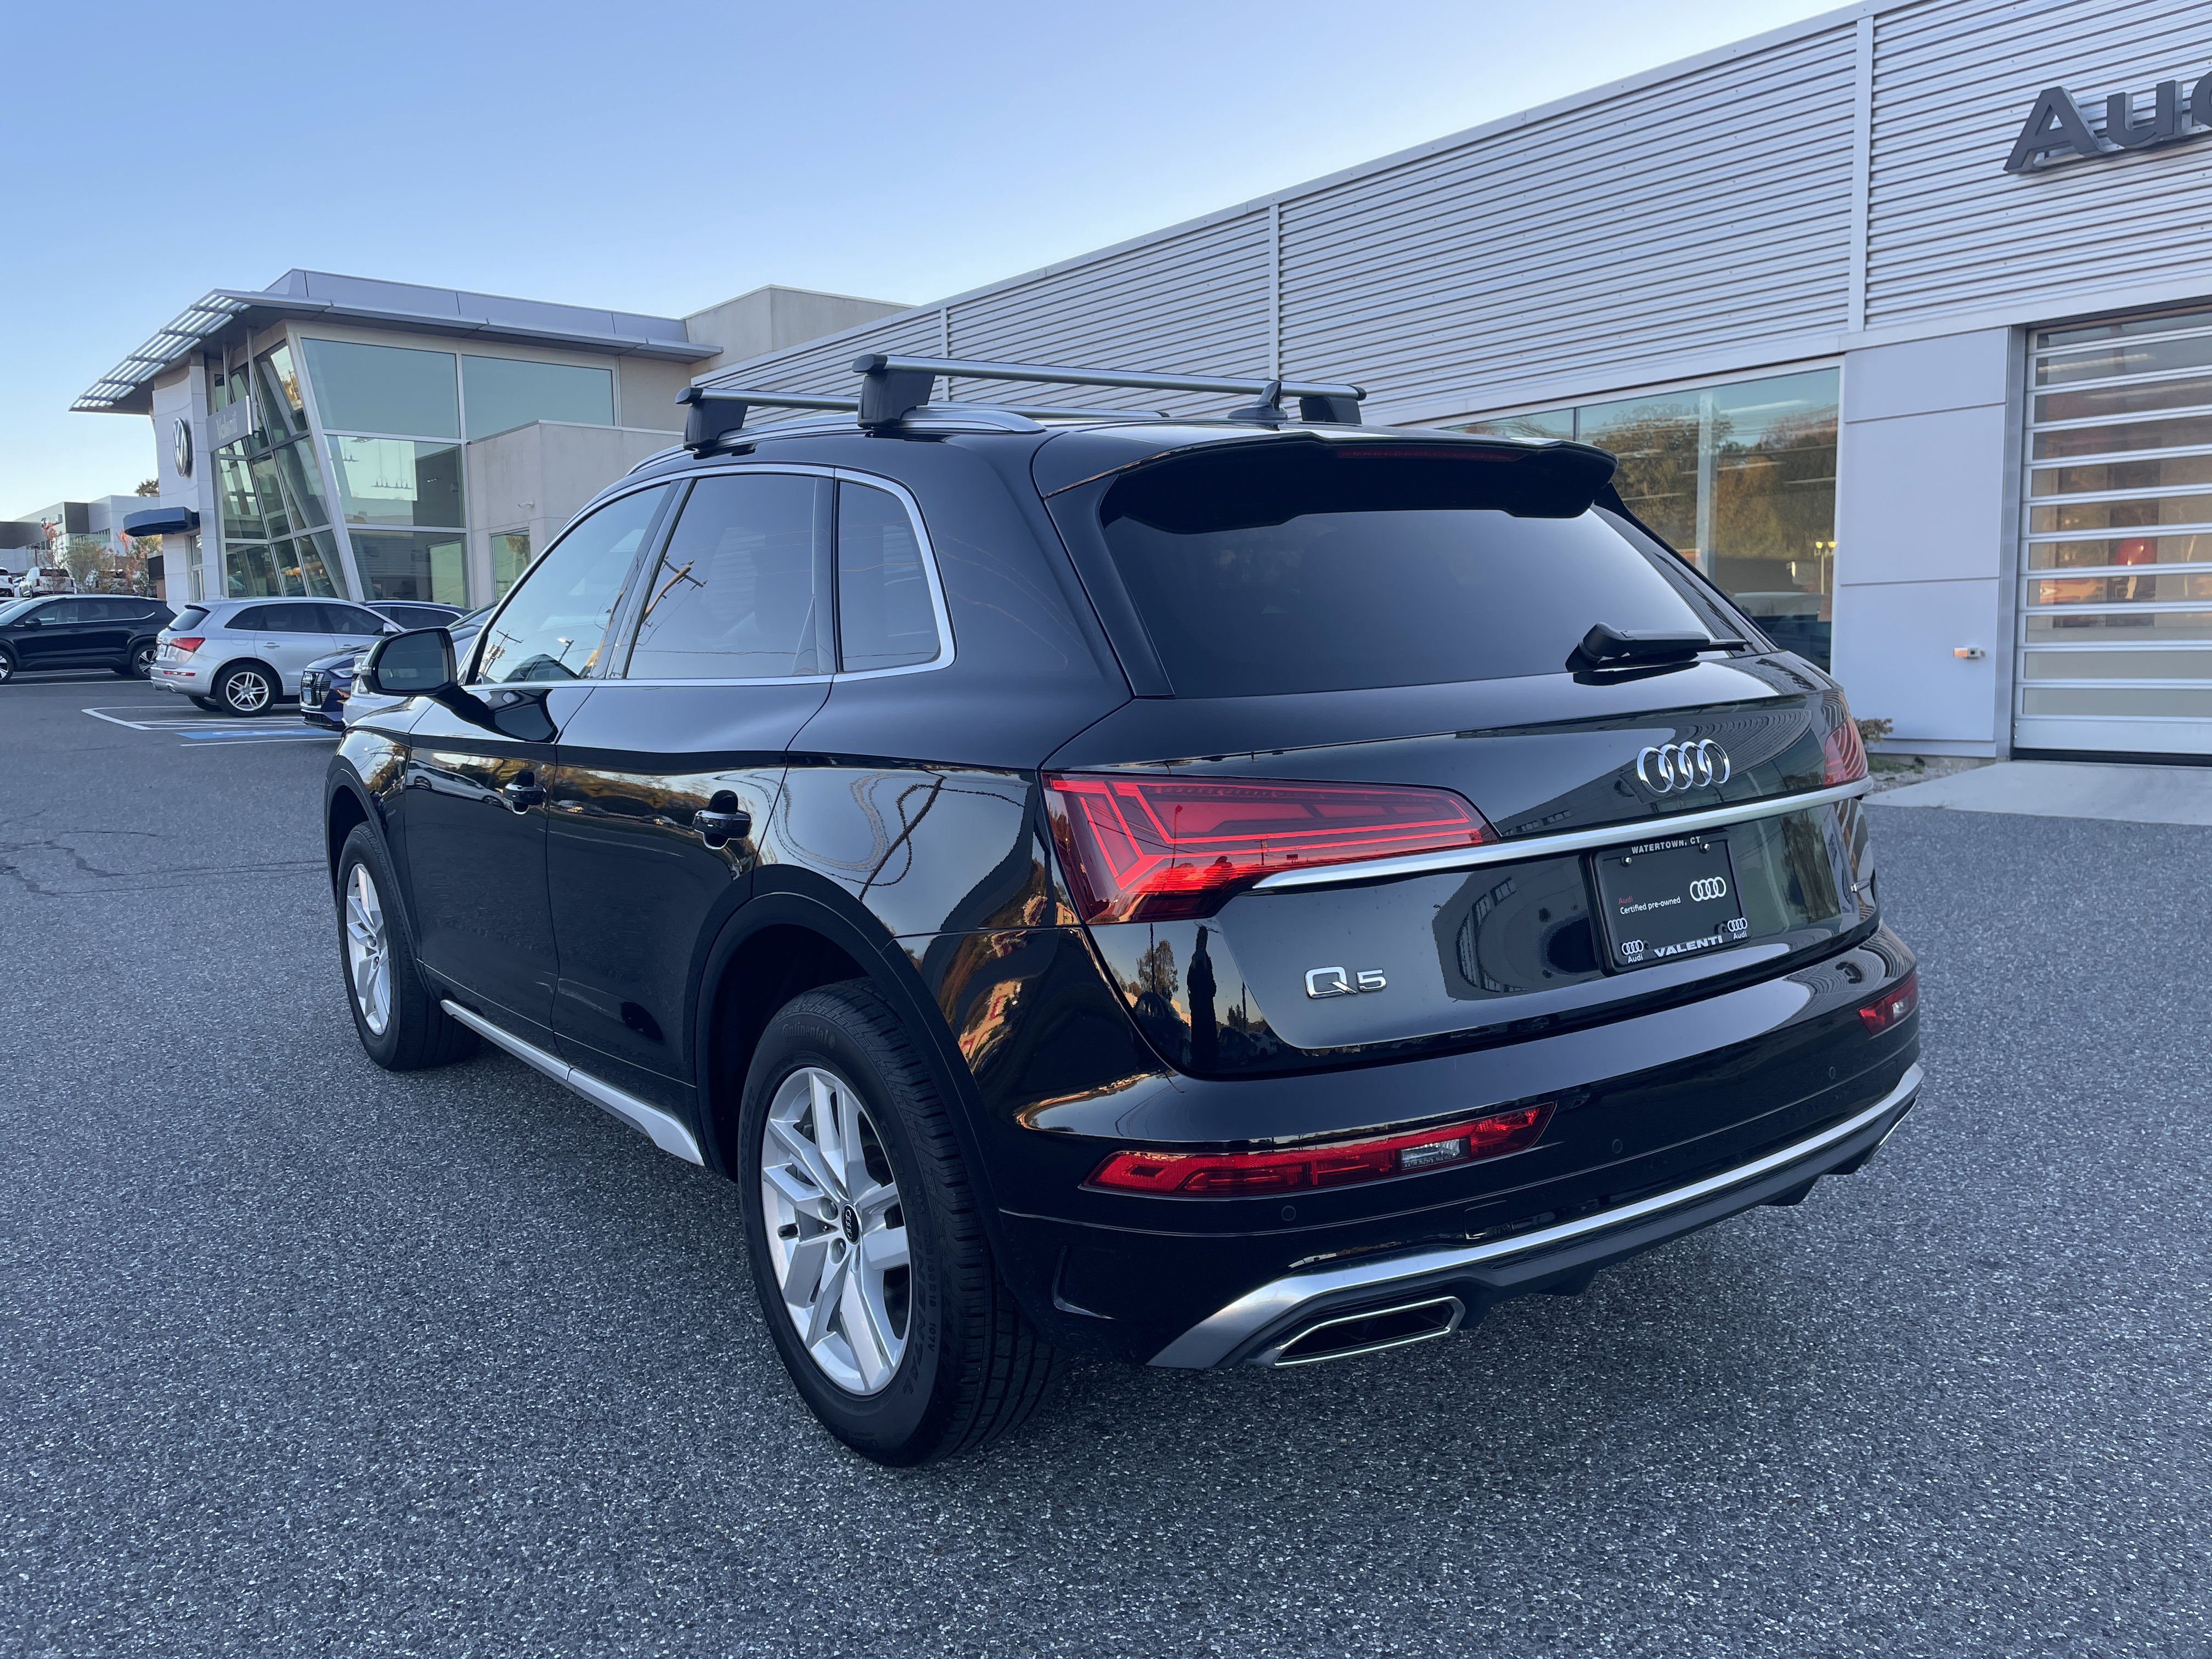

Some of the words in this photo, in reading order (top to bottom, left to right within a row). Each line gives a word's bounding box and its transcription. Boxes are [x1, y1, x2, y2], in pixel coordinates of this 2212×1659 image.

[2003, 71, 2212, 174] Au
[1631, 839, 1688, 854] WATERTOWN,
[1689, 836, 1701, 845] CT
[1618, 895, 1633, 905] Audi
[1620, 902, 1646, 915] Certified
[1648, 896, 1681, 911] pre-owned
[1733, 931, 1747, 940] Audi
[1654, 935, 1723, 957] VALENTI
[1627, 953, 1644, 963] Audi
[1305, 966, 1387, 998] Q5
[782, 1022, 828, 1045] Continental
